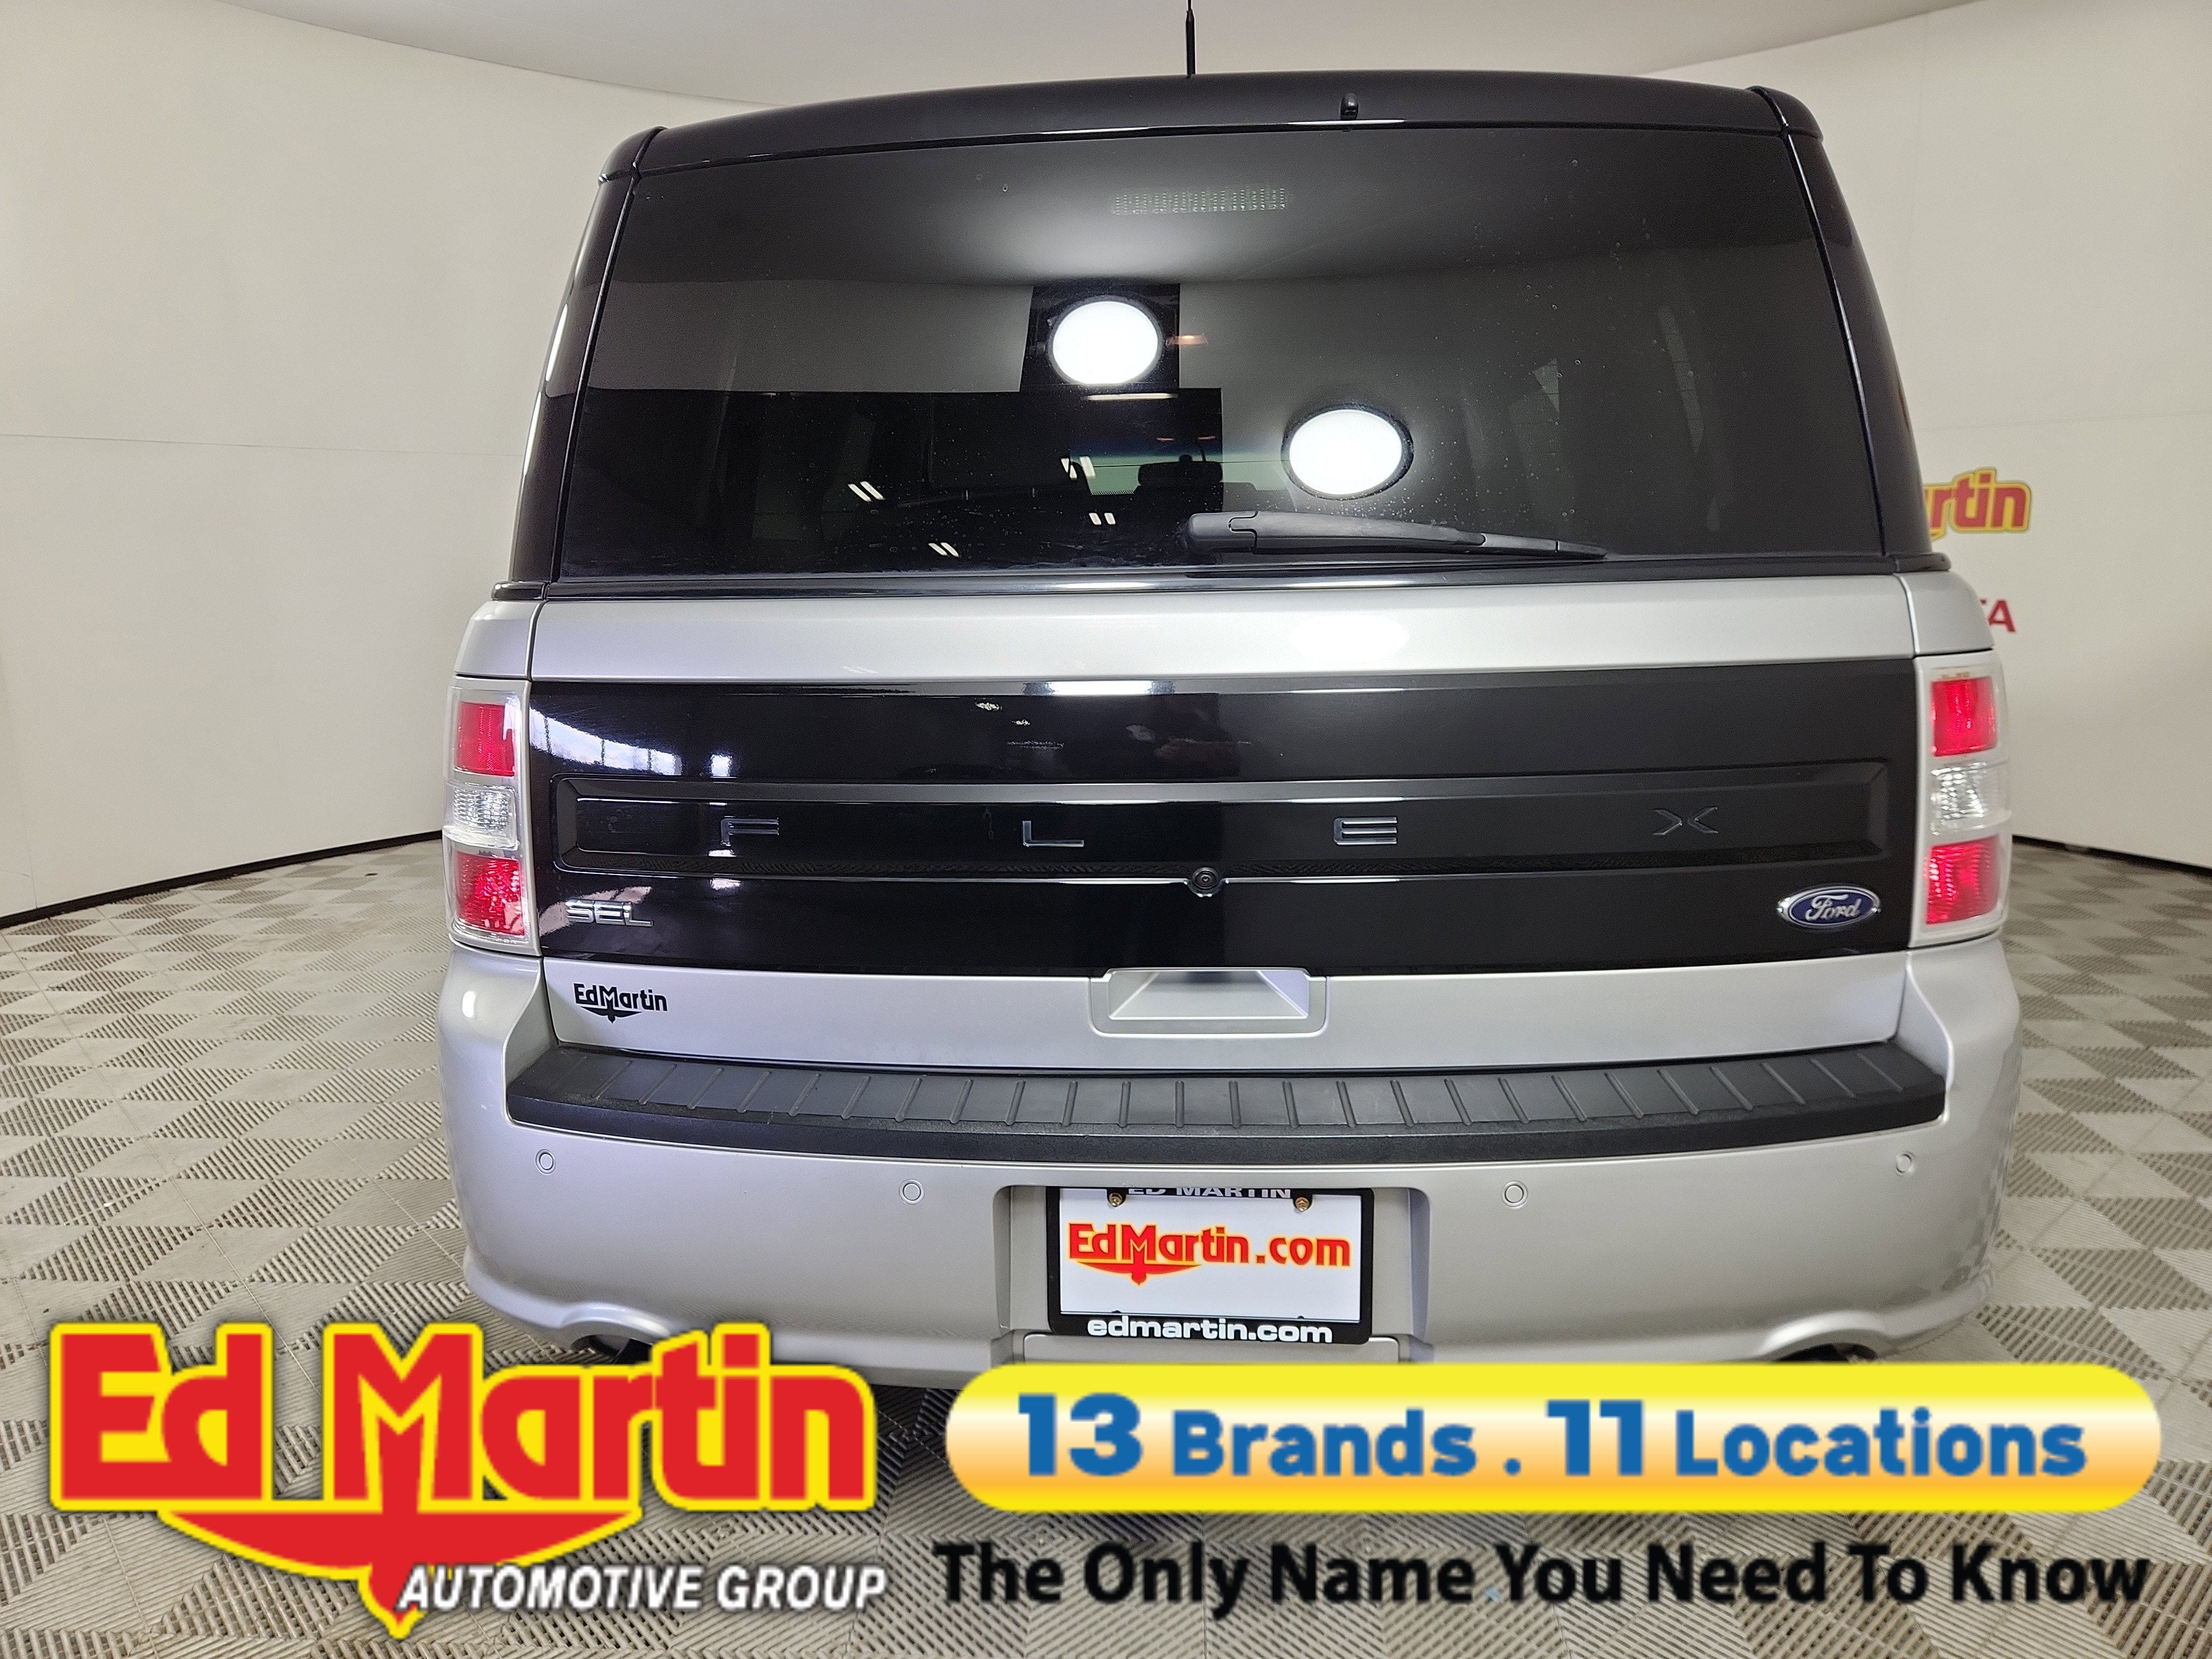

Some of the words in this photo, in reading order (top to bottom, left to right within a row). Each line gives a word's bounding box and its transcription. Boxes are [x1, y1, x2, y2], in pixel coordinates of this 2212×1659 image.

[565, 898, 653, 927] SEL
[1805, 895, 1862, 921] Ford
[1087, 1315, 1333, 1343] edmartin.com
